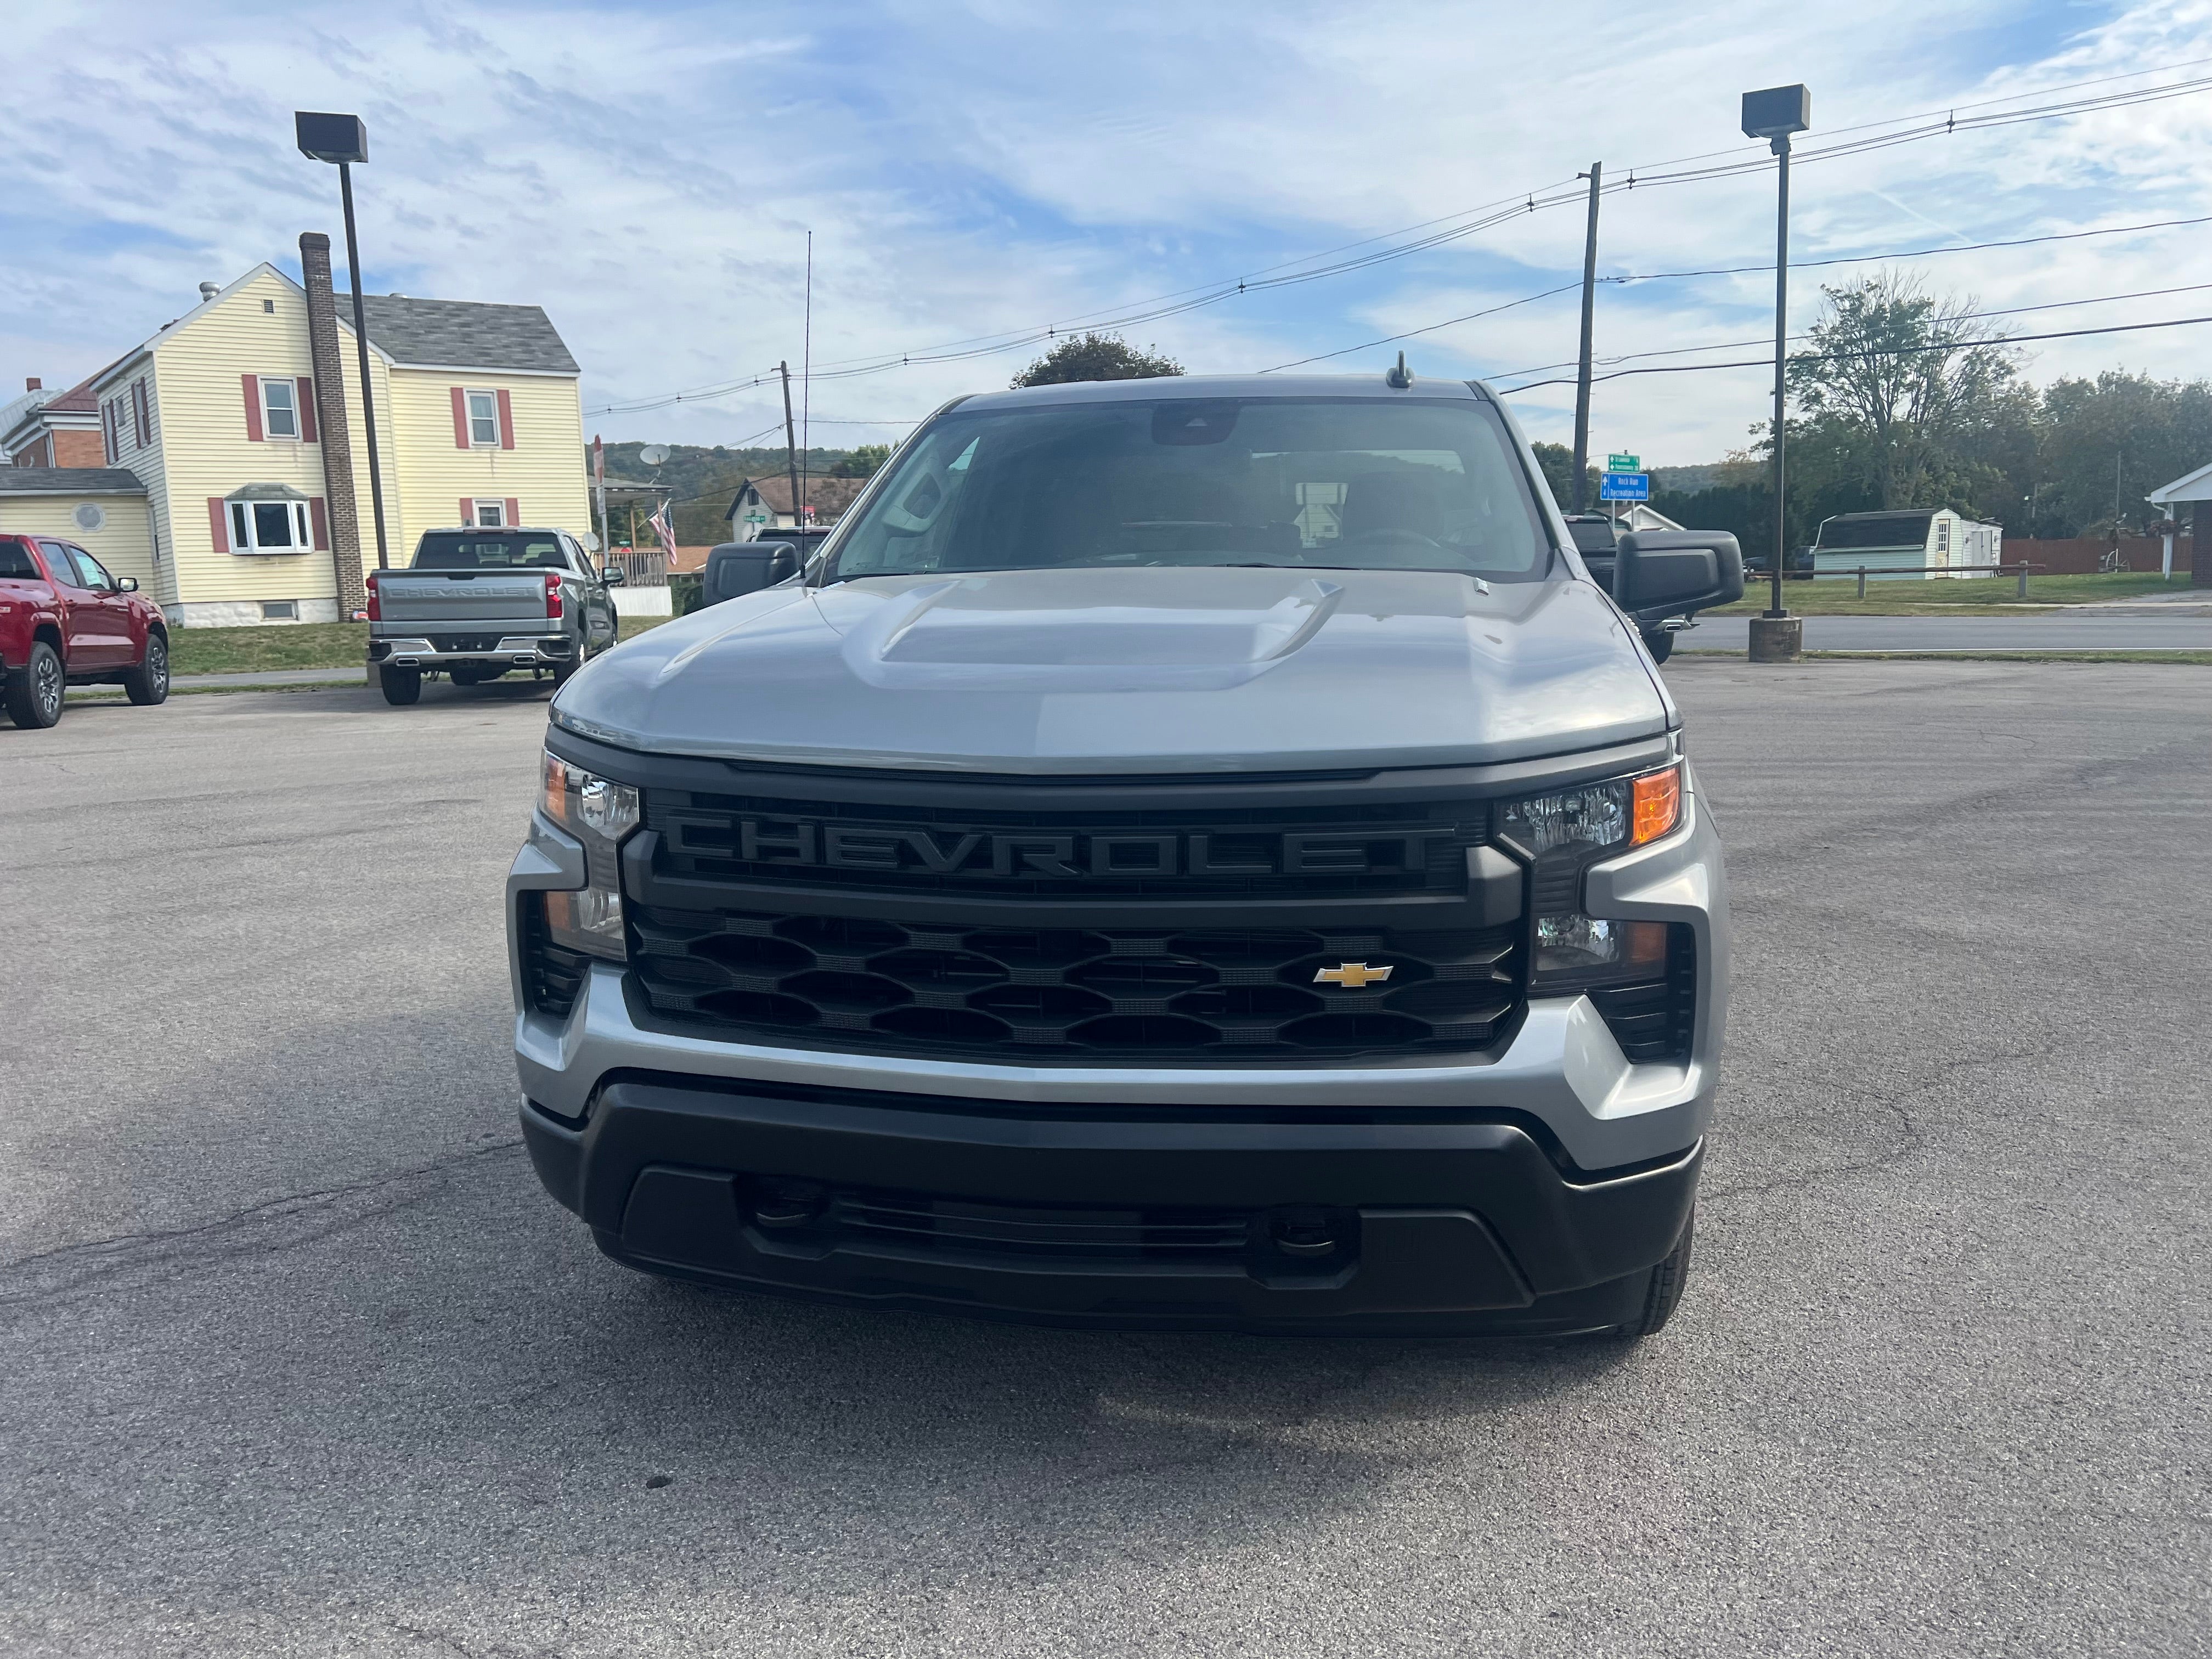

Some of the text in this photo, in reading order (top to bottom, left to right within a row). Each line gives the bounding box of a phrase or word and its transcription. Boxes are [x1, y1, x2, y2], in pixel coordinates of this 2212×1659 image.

[1618, 477, 1639, 486] Rock Run
[1610, 488, 1646, 497] Recreation Area
[390, 587, 536, 597] CHEVROLET
[665, 814, 1457, 877] CHEVROLET
